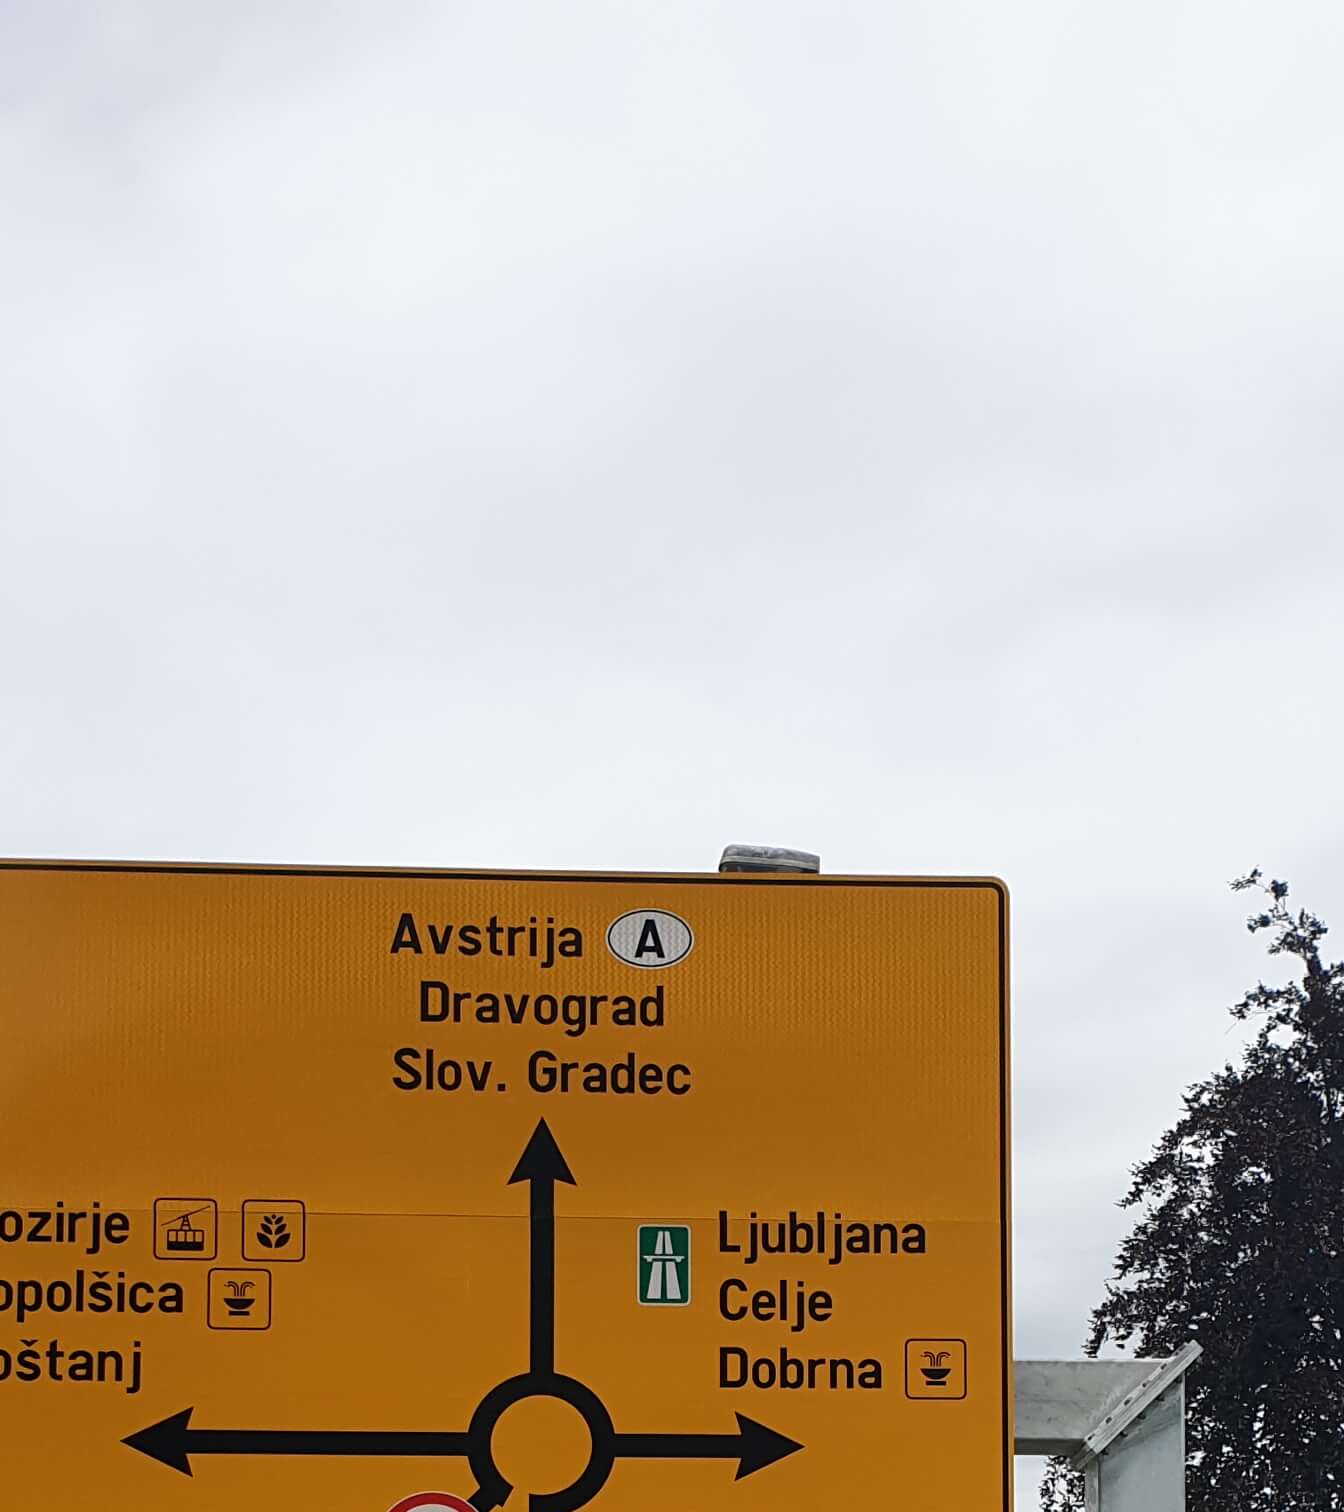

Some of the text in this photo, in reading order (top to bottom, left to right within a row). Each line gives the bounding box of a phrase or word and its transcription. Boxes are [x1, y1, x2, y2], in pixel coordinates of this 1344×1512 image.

[390, 912, 666, 969] Avstrija A
[420, 980, 664, 1036] Dravograd
[392, 1047, 691, 1096] Slov. Gradec
[719, 1210, 926, 1265] Ljubljana
[719, 1278, 833, 1333] Celje
[719, 1346, 882, 1390] Dobrna
